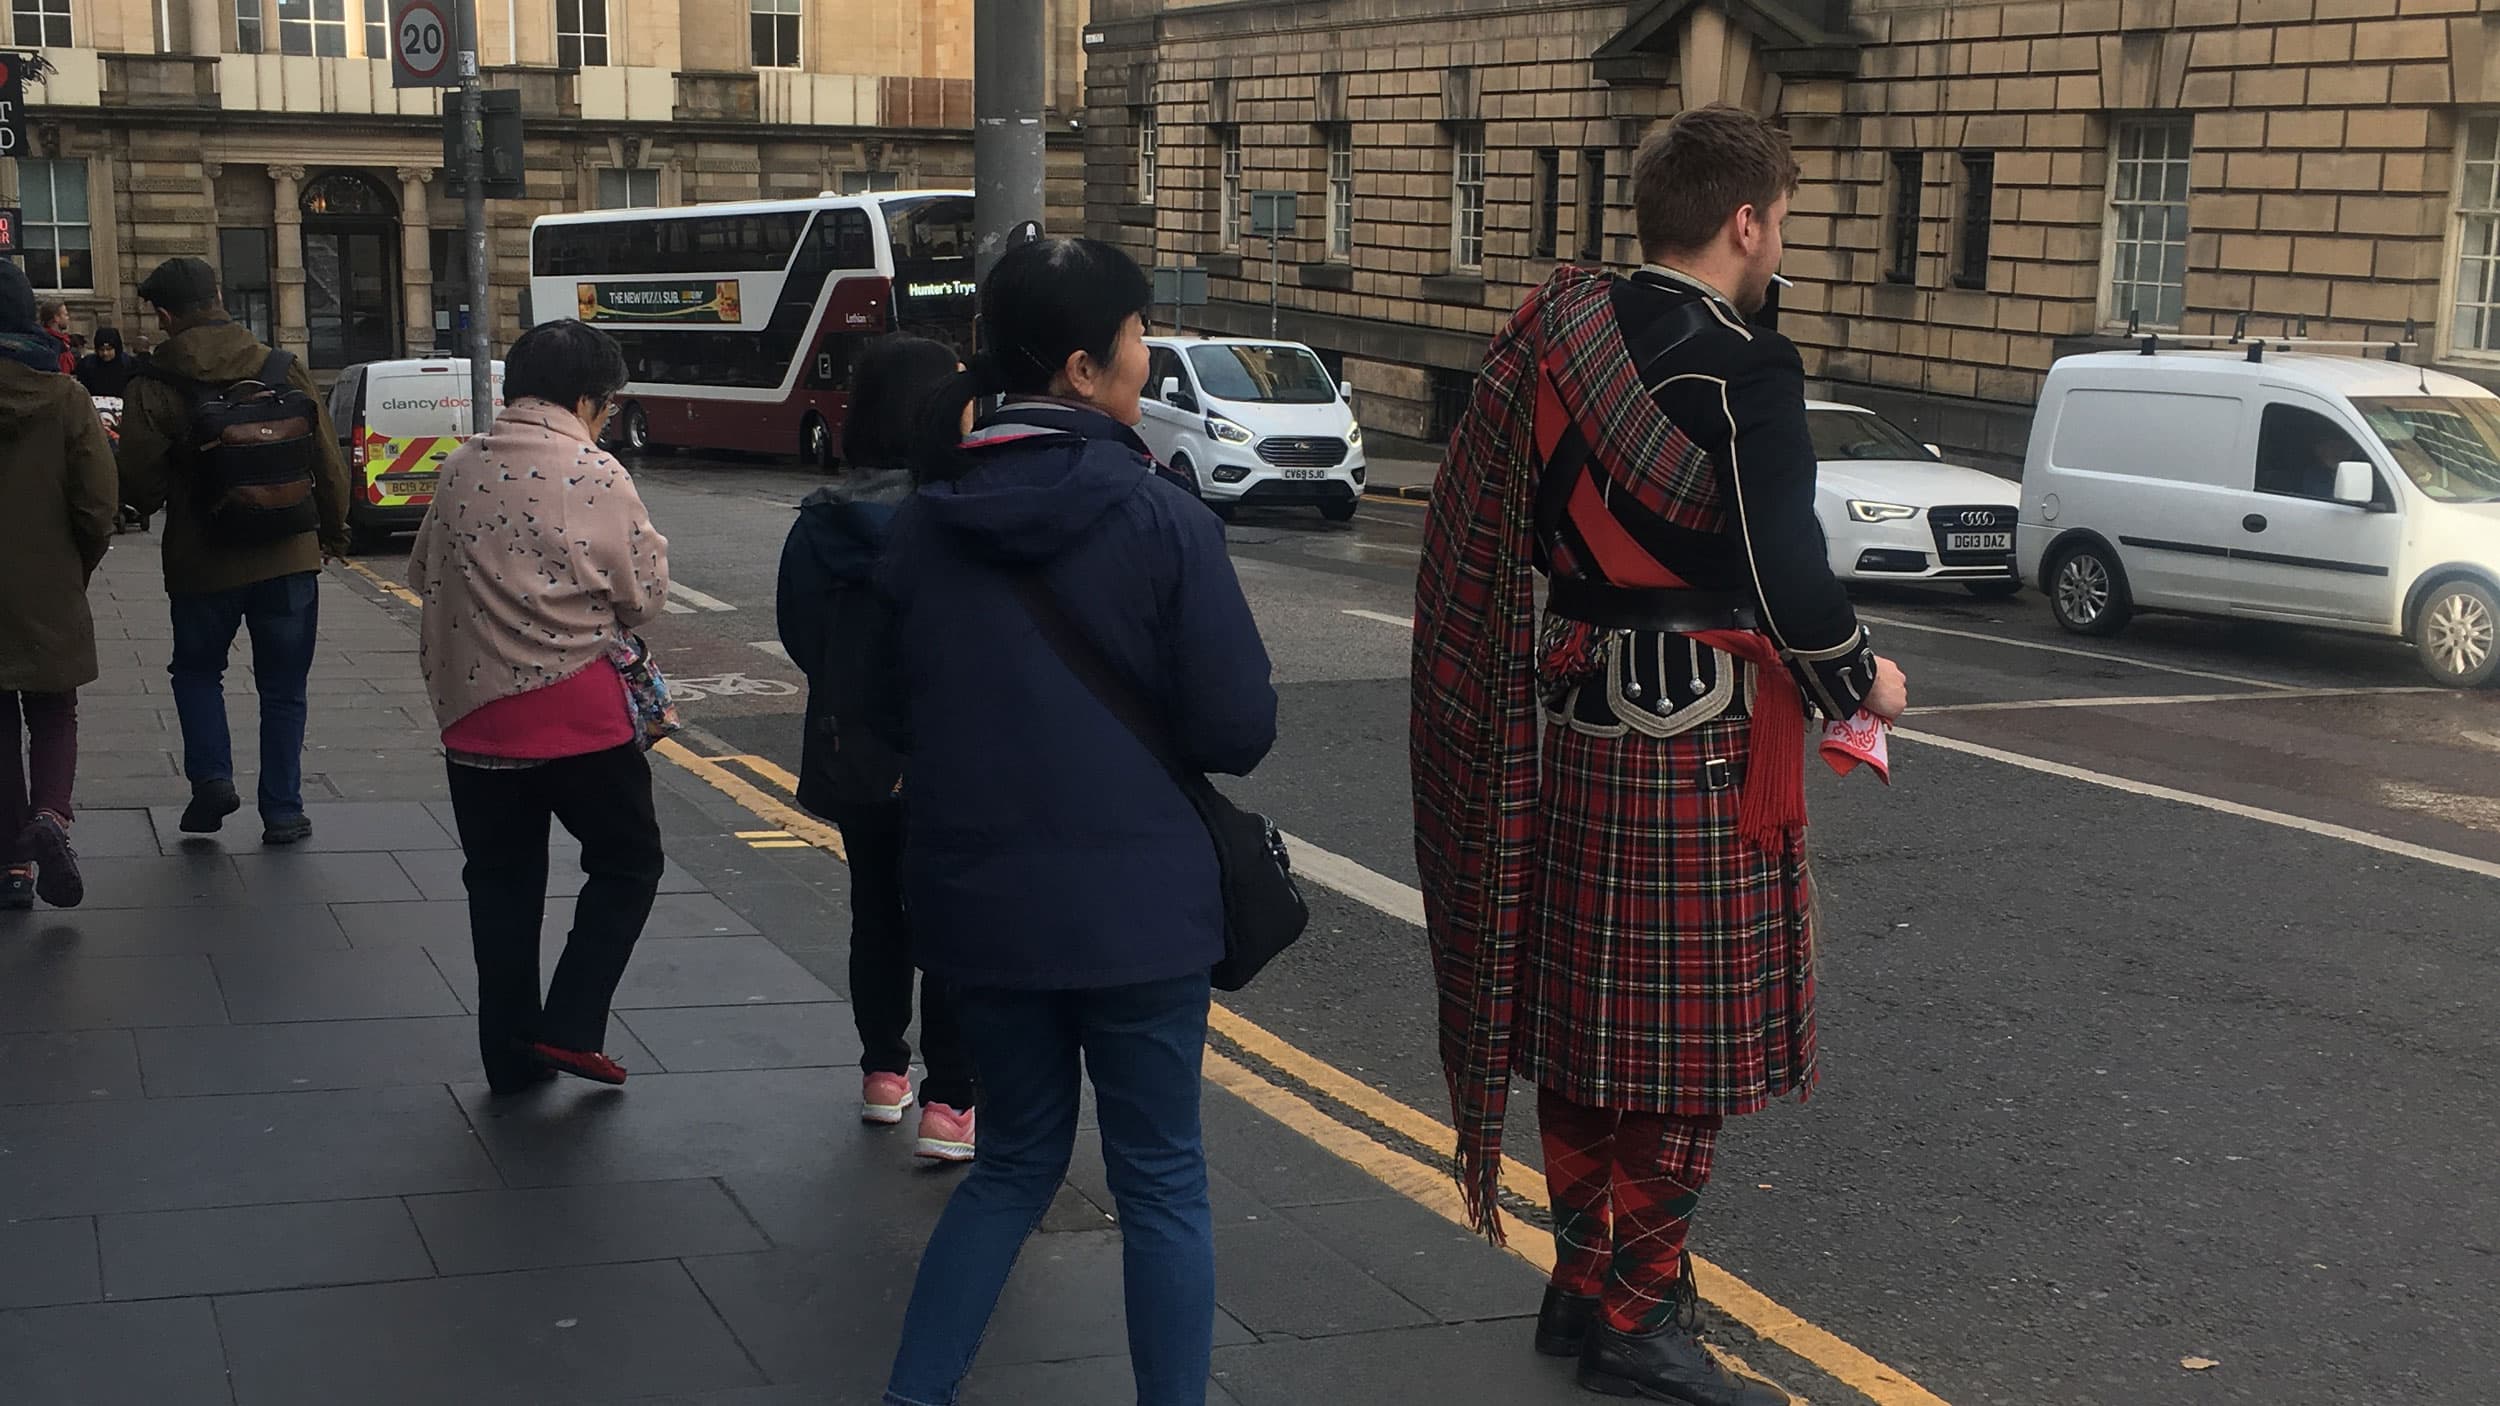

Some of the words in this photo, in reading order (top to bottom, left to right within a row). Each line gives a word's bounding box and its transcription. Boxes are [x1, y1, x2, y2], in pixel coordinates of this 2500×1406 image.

[403, 24, 441, 54] 20
[909, 283, 952, 296] Hunter's
[609, 292, 624, 305] THE
[624, 291, 641, 304] NEW
[1954, 535, 1981, 548] DG13
[1983, 535, 2005, 548] DAZ
